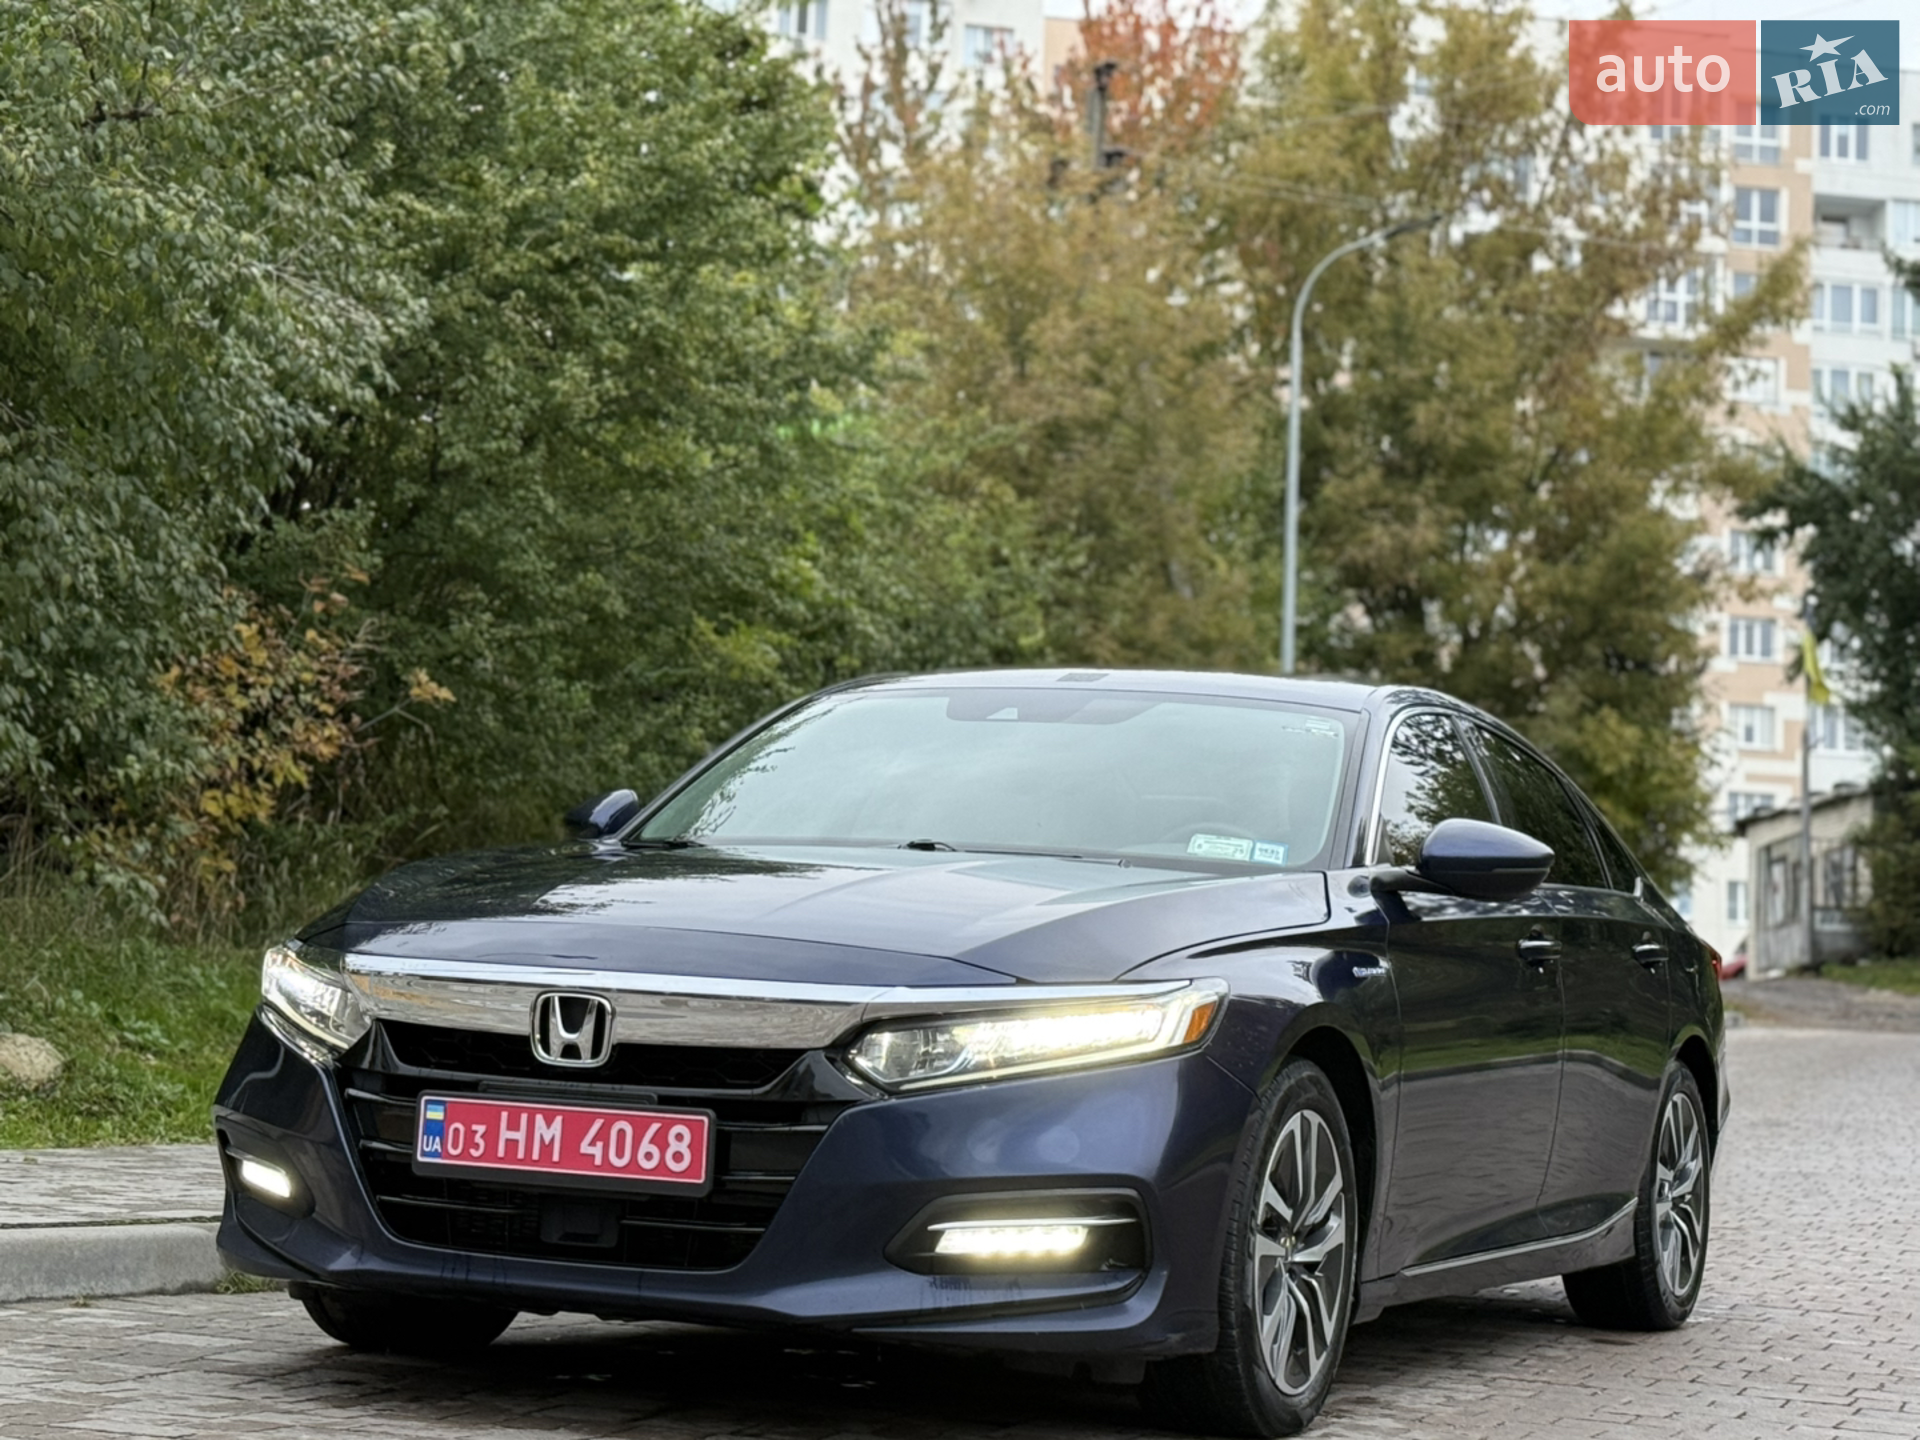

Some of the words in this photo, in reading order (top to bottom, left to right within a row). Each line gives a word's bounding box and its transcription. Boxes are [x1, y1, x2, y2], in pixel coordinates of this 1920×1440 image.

[423, 1135, 442, 1153] UA
[447, 1122, 487, 1157] 03
[497, 1111, 563, 1162] HM
[579, 1118, 692, 1173] 4068
